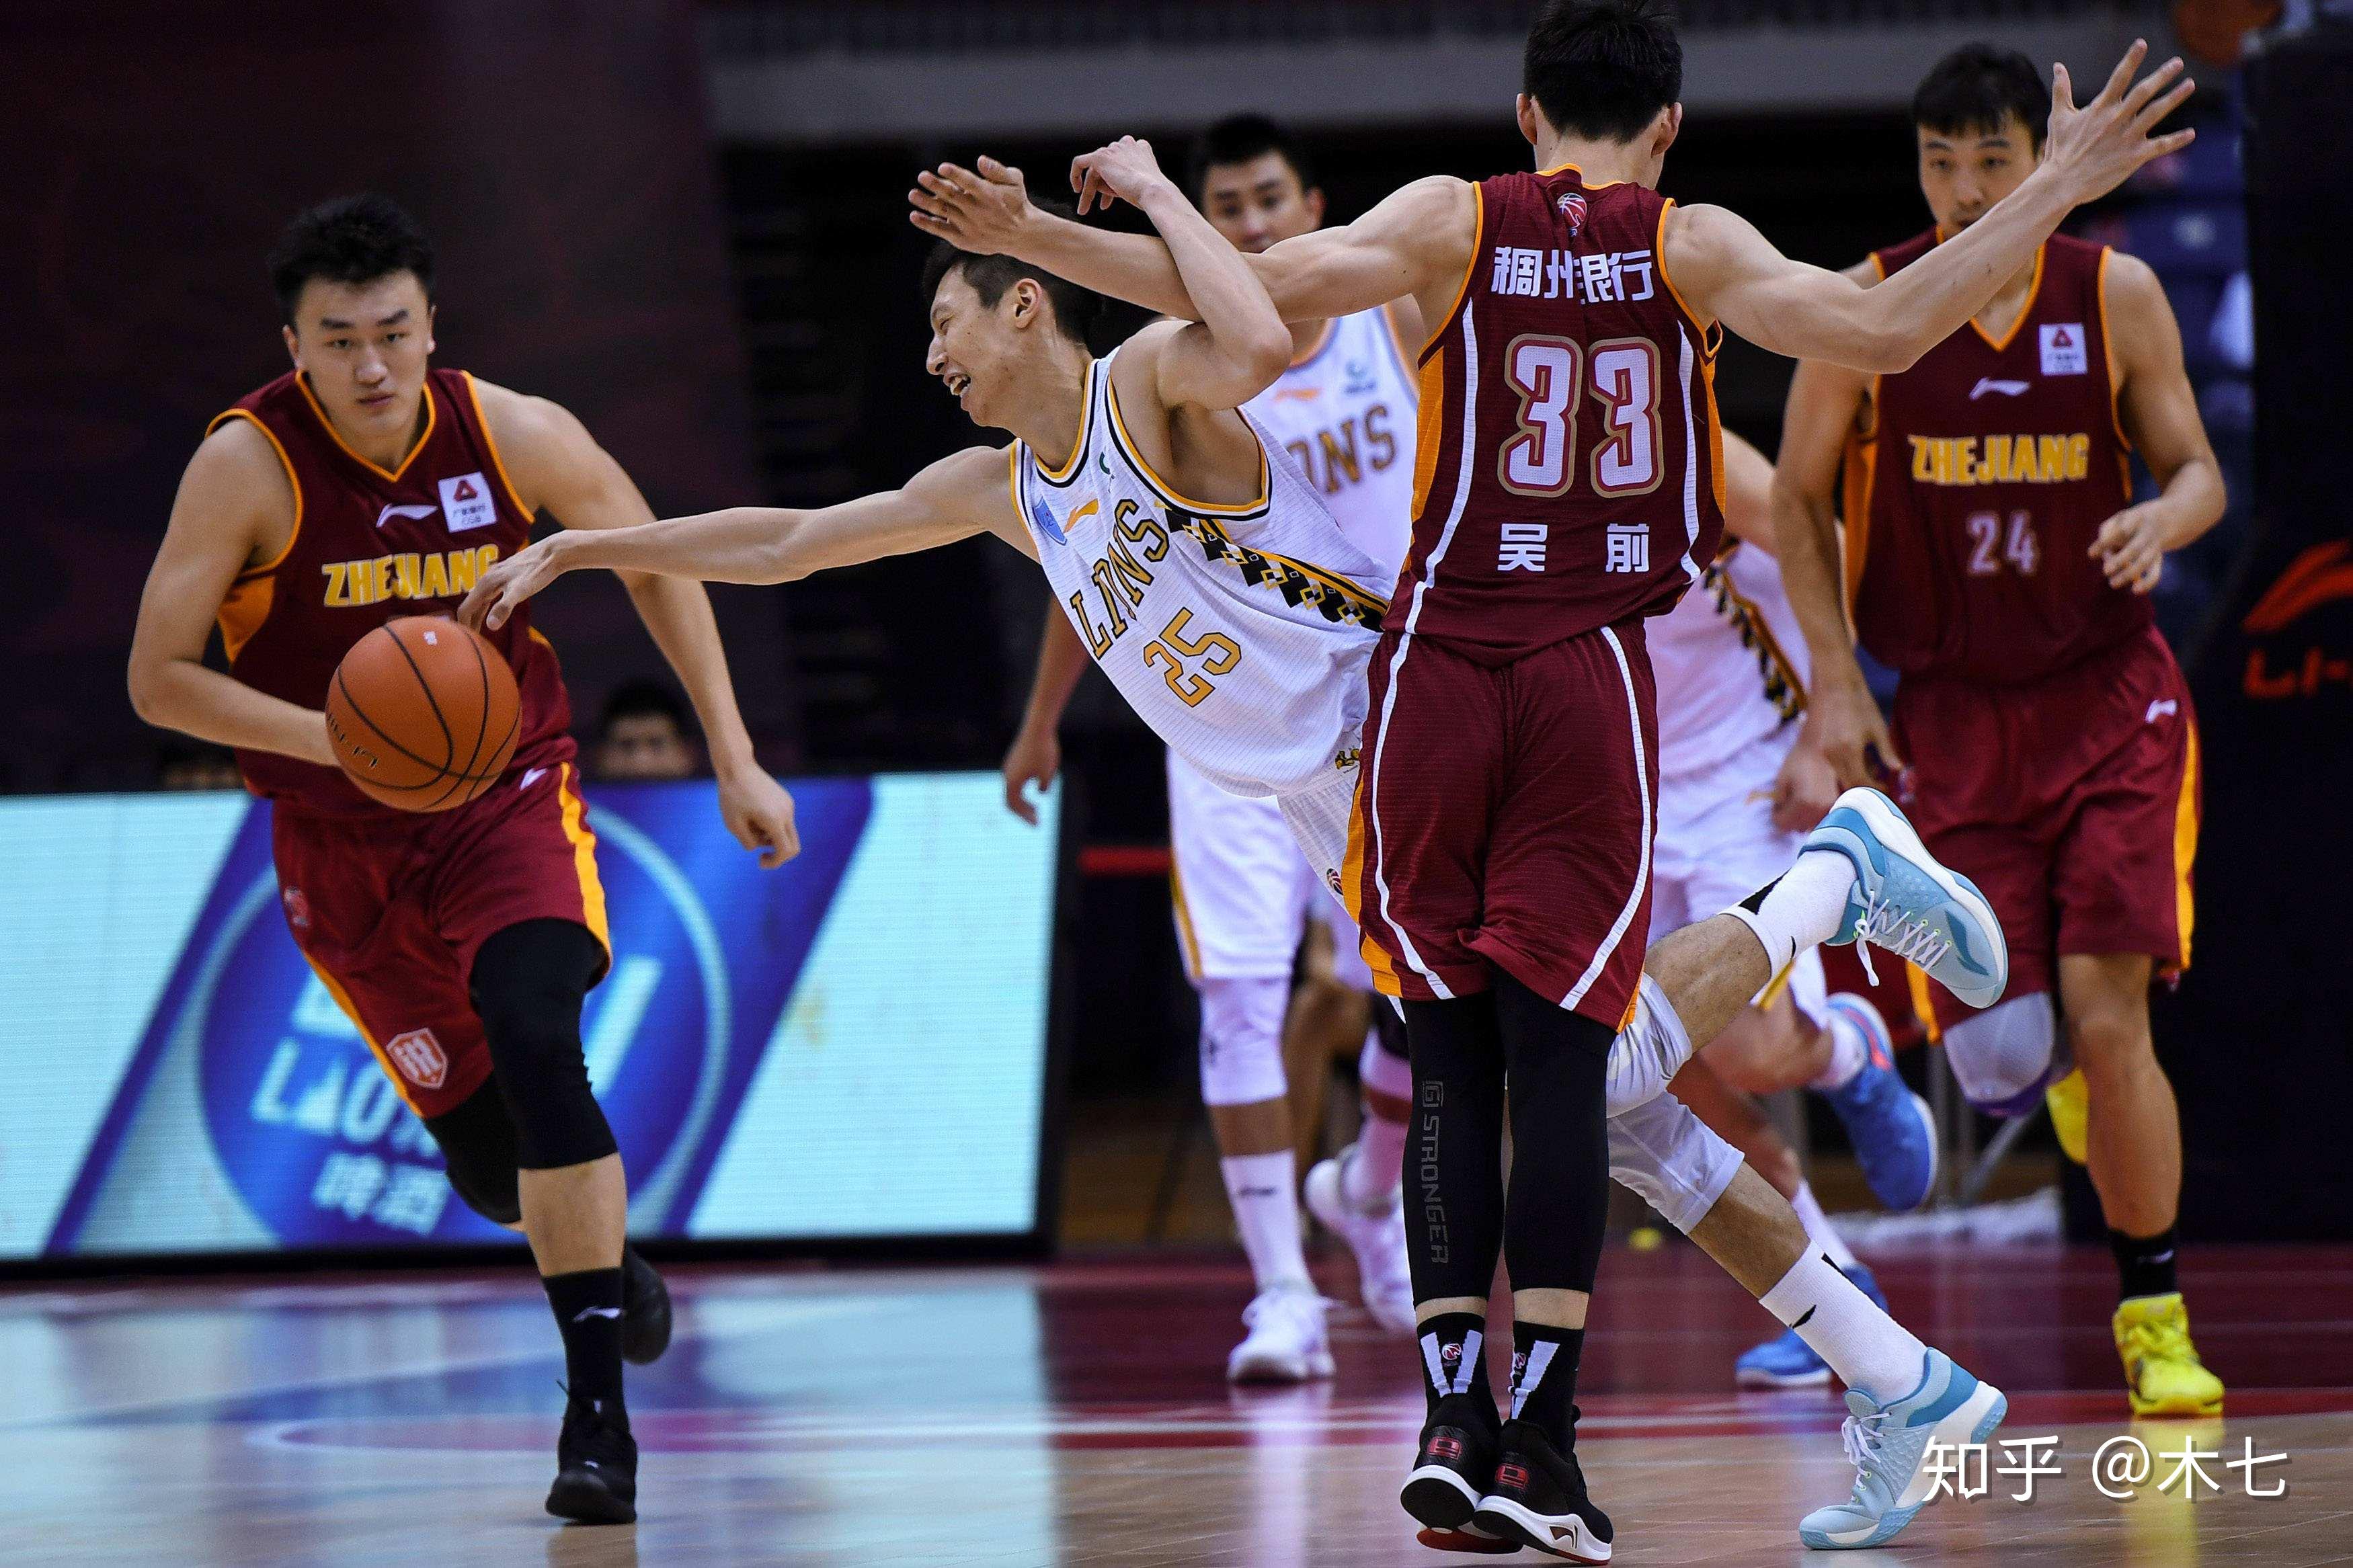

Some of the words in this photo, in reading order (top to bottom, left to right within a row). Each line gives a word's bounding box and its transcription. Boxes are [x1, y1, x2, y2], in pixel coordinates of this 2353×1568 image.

[1490, 245, 1654, 304] 稠州银行
[1497, 333, 1665, 499] 33
[1907, 433, 2090, 486] ZHEJIANG
[1497, 523, 1548, 573] 吴
[1605, 523, 1650, 573] 前
[1965, 509, 2042, 577] 24
[1143, 606, 1242, 708] 25
[1421, 1114, 1450, 1264] STRONGER
